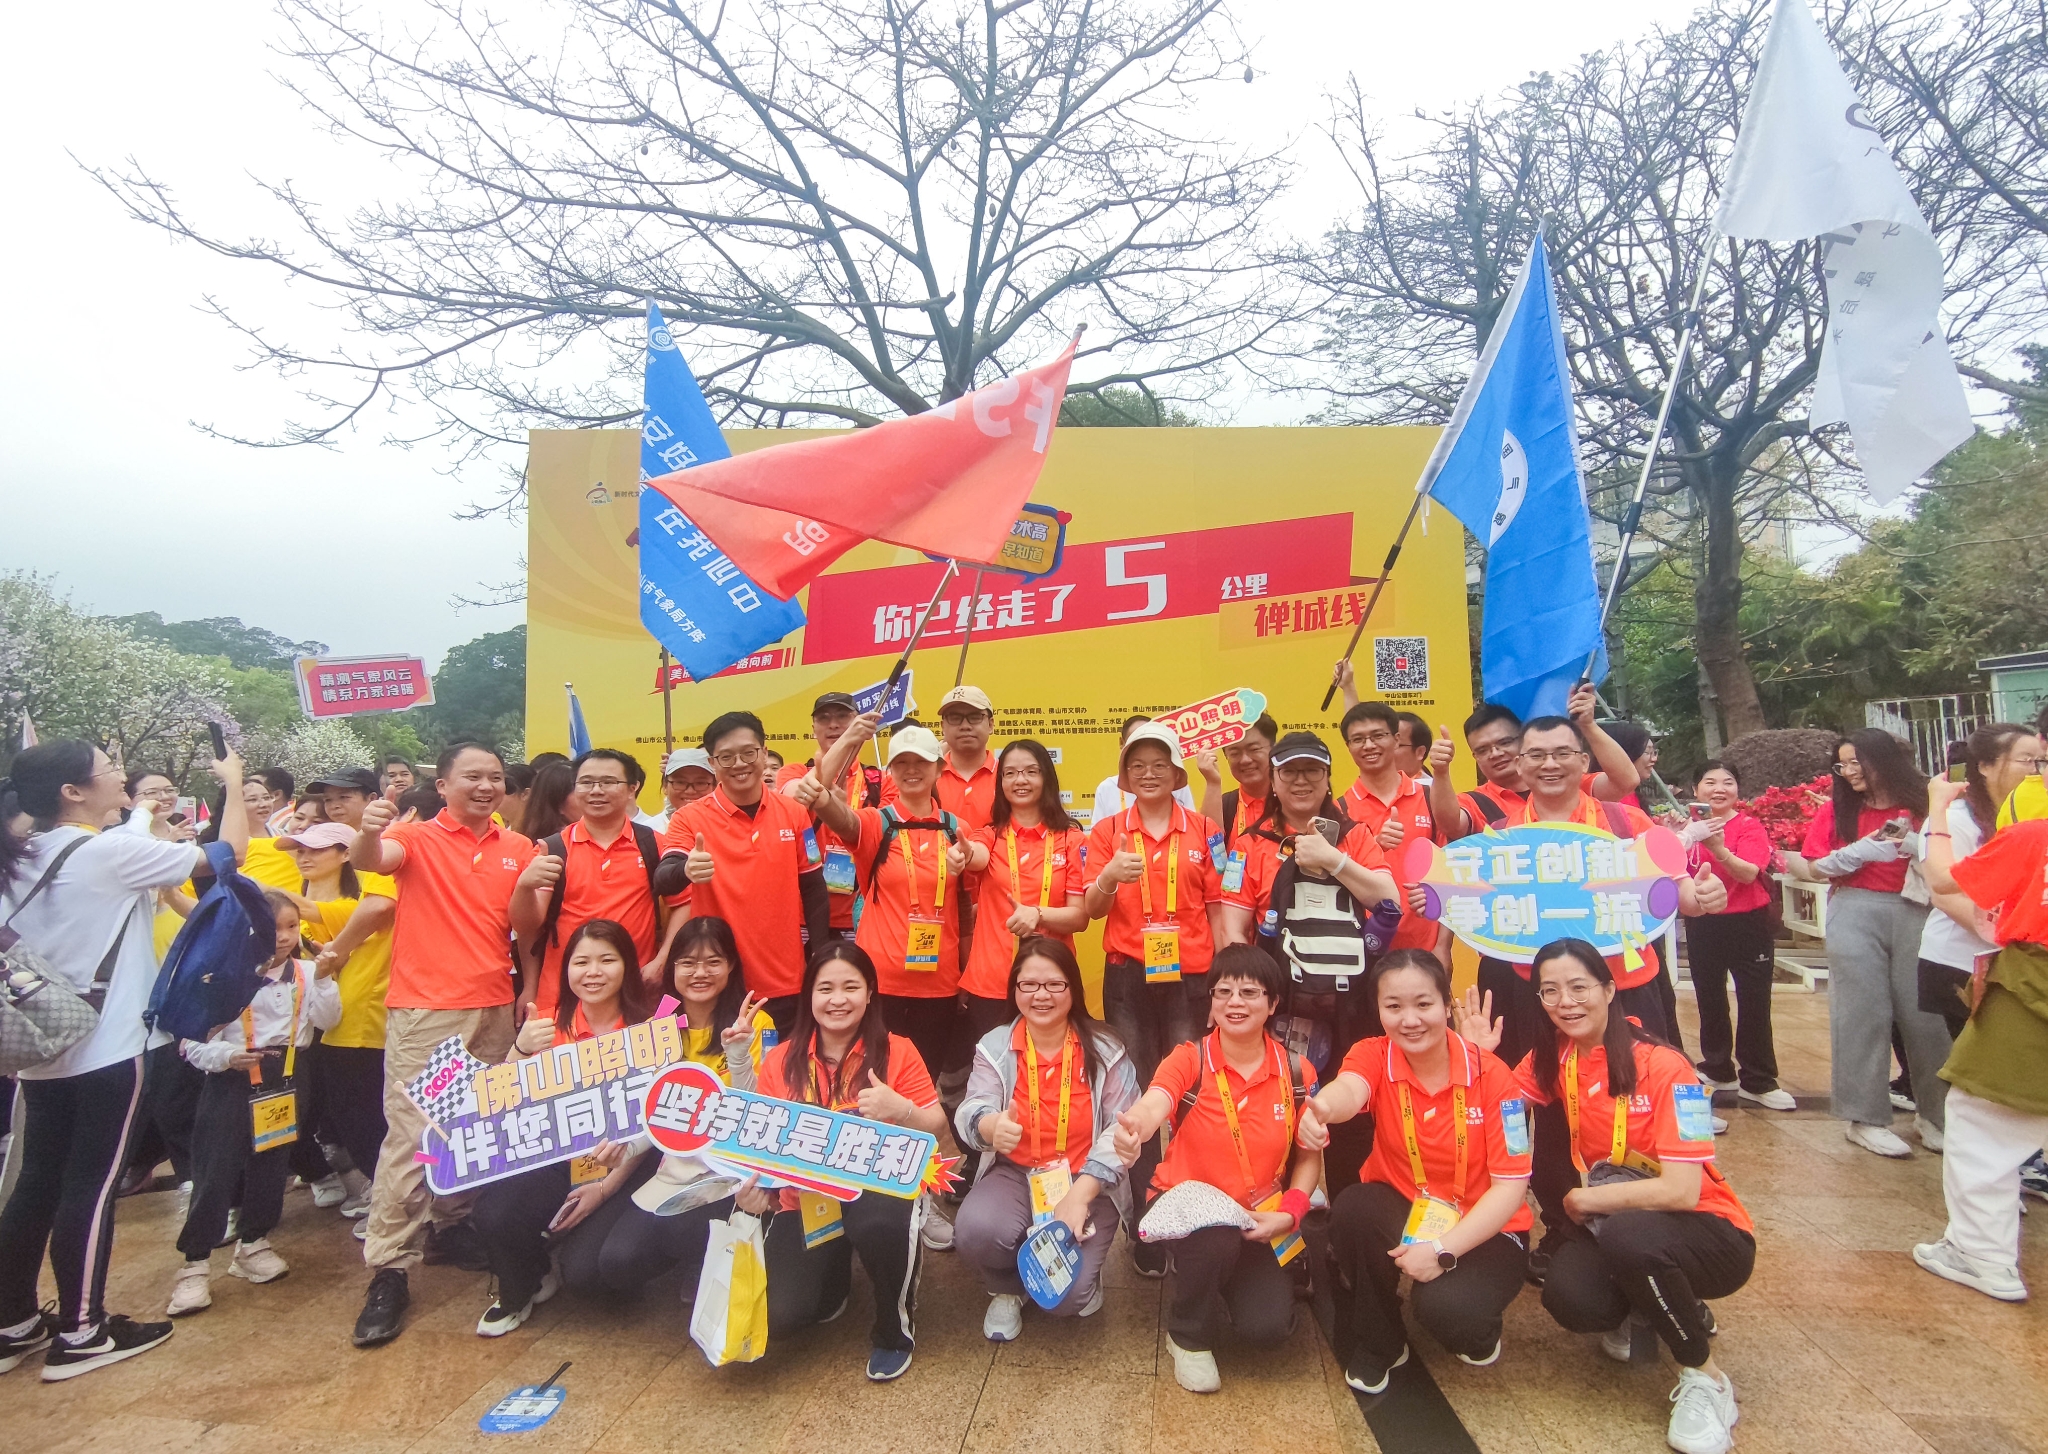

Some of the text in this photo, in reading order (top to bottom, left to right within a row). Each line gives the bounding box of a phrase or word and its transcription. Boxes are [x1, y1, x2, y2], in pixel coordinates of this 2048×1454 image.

[654, 504, 763, 614] 在我心中
[1002, 542, 1044, 563] 早知道
[872, 541, 1269, 644] 你已经走了 5 公里
[1254, 592, 1367, 637] 禅城线
[319, 668, 413, 687] 精测气象风云
[322, 682, 416, 703] 情系万家冷暖
[780, 829, 795, 837] FSL
[1415, 815, 1431, 823] FSL
[503, 857, 518, 866] FSL
[827, 863, 840, 871] FSL
[1188, 850, 1203, 859] FSL
[1445, 838, 1638, 883] 守正创新
[1447, 891, 1646, 935] 争创一流
[423, 1057, 465, 1101] 2024
[471, 1014, 683, 1118] 佛山照明
[447, 1071, 655, 1178] 伴您同行
[647, 1080, 928, 1186] 坚持就是胜利
